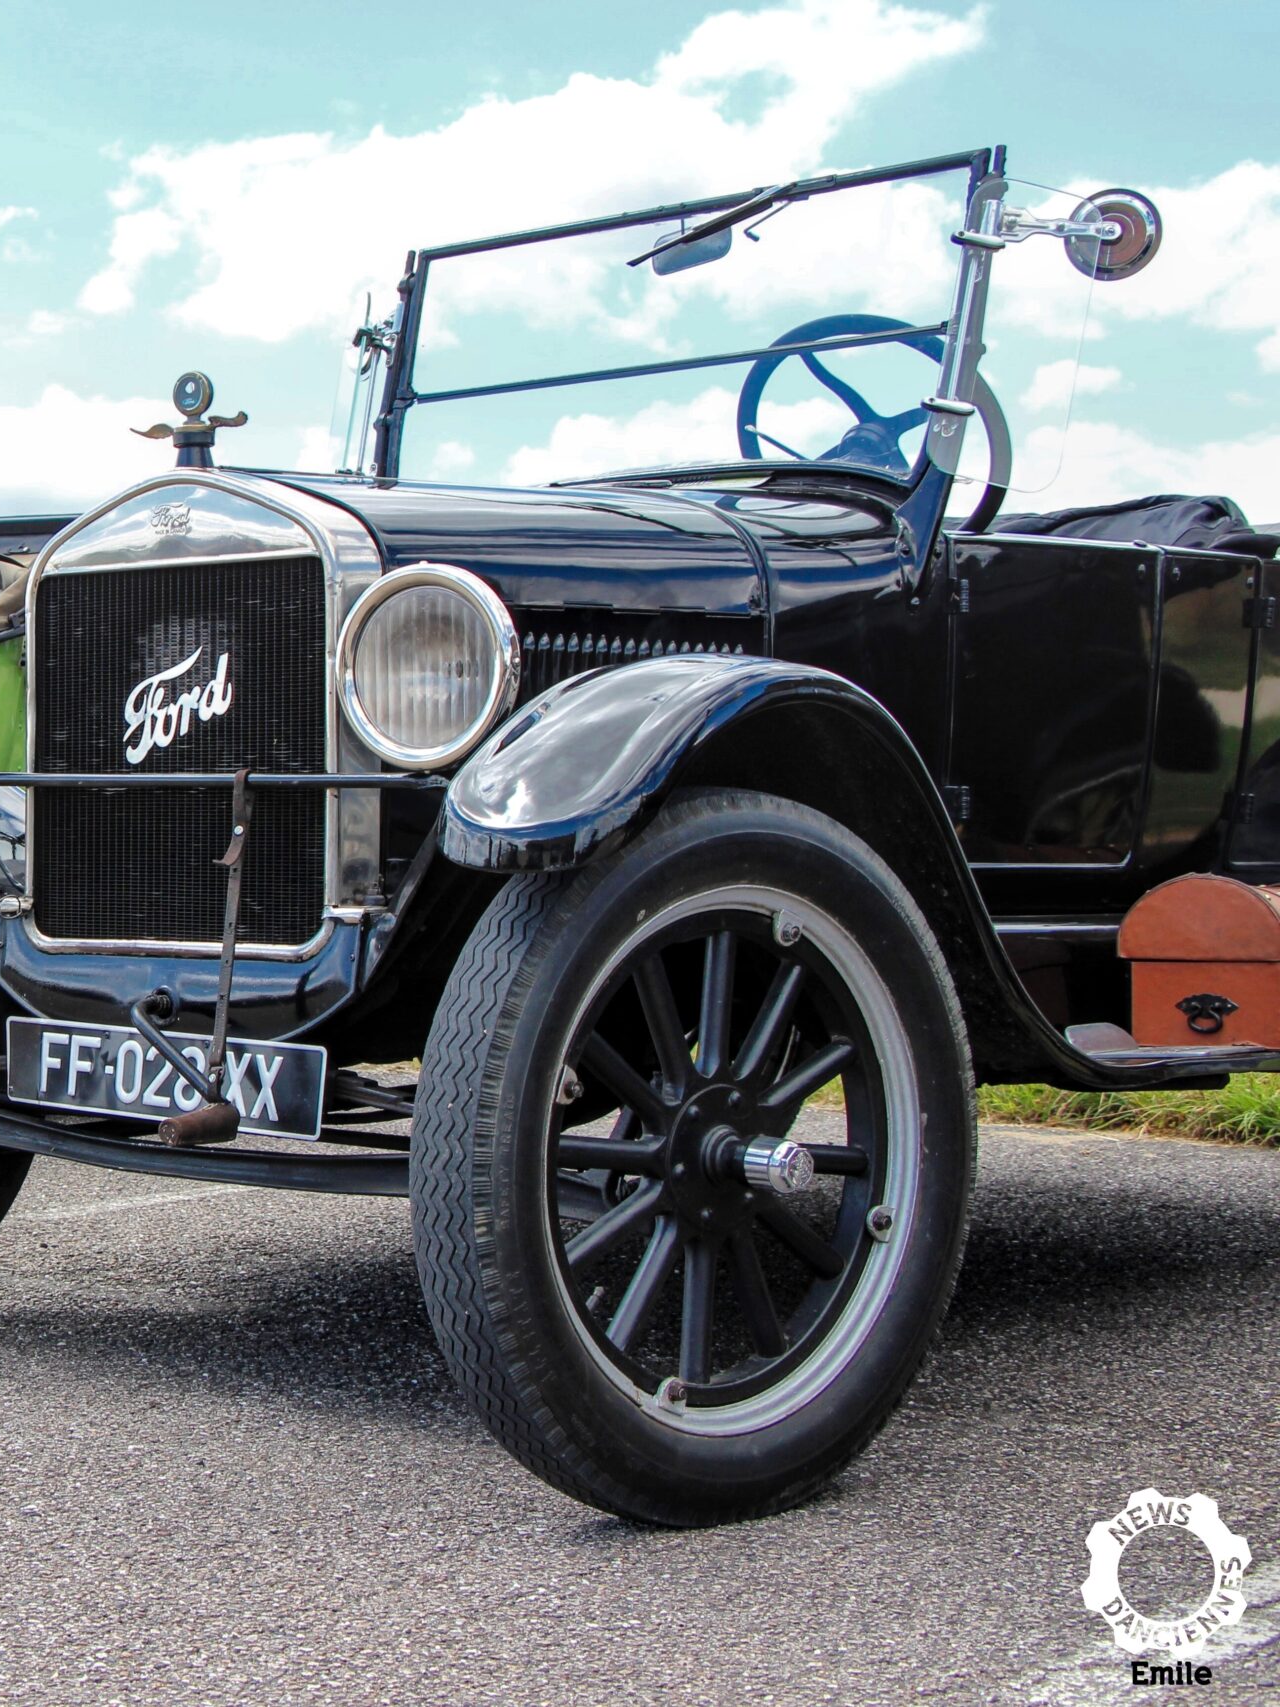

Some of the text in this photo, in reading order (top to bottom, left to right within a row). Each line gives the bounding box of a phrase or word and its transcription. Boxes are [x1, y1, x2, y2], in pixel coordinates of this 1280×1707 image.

[151, 503, 192, 528] Ford
[124, 645, 233, 765] Ford
[39, 1031, 284, 1122] FF-028XX
